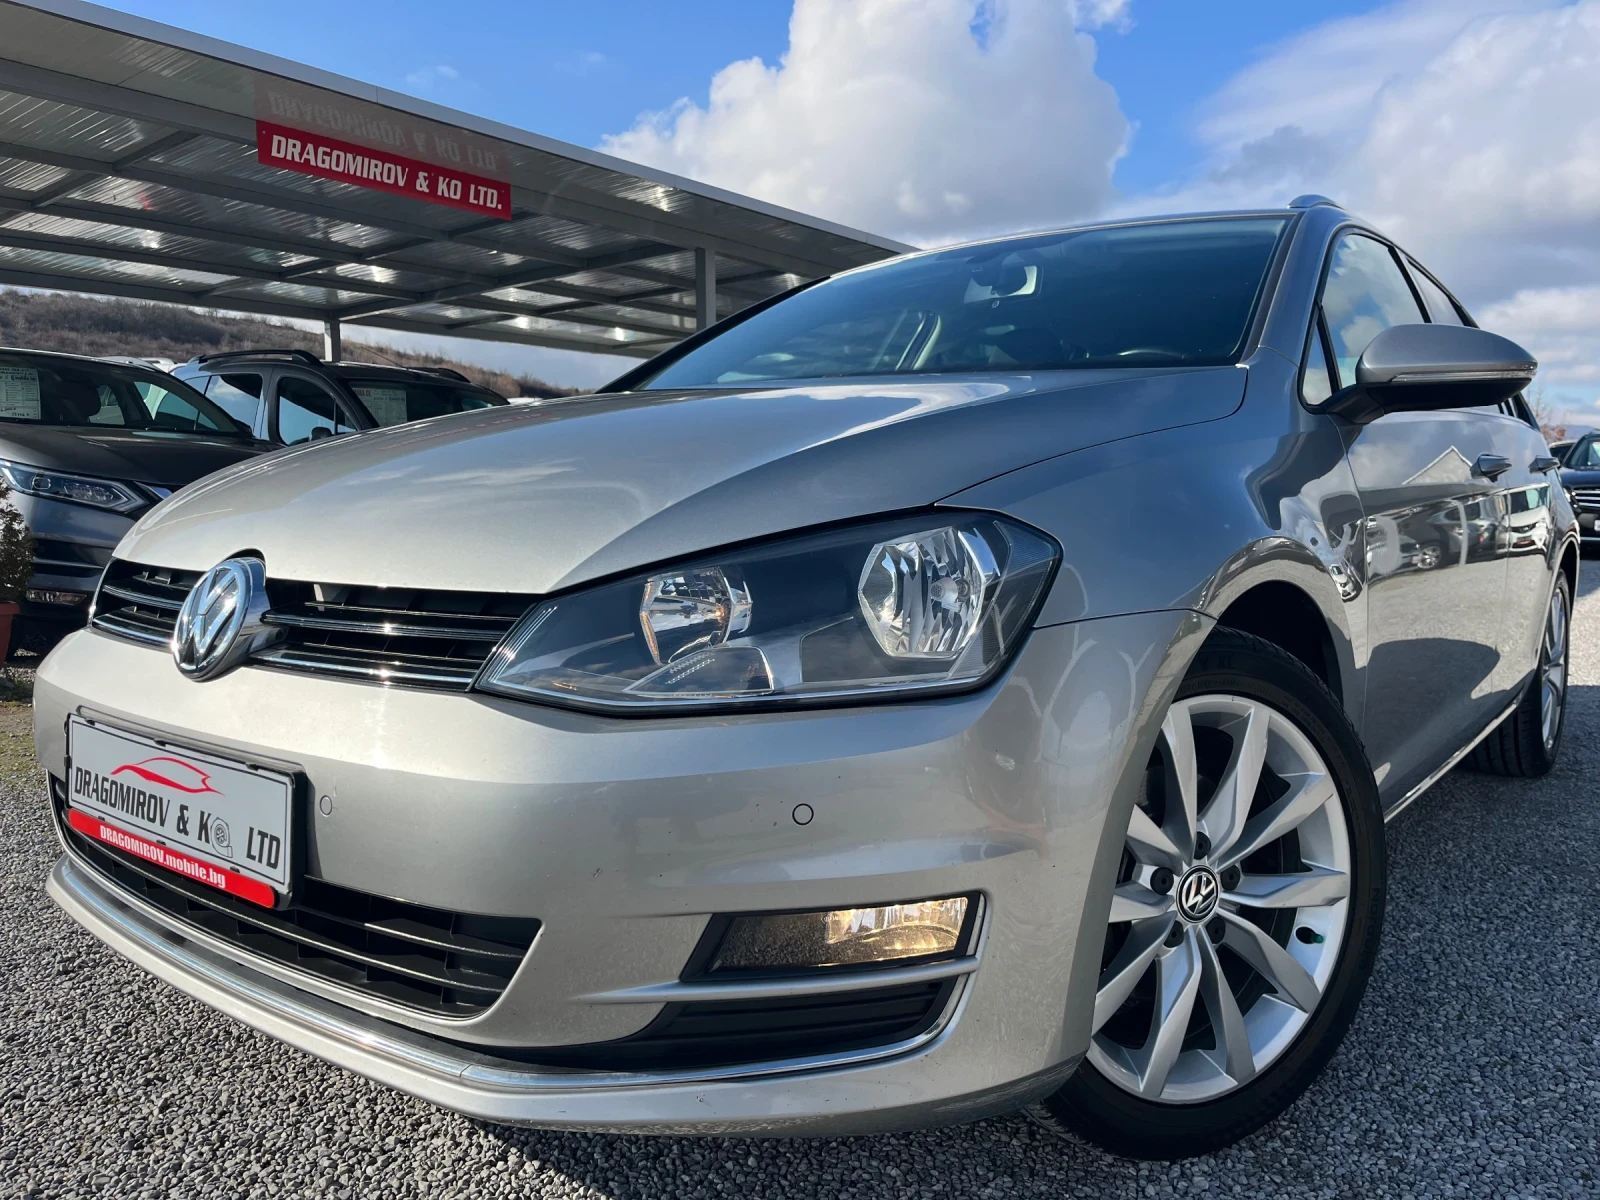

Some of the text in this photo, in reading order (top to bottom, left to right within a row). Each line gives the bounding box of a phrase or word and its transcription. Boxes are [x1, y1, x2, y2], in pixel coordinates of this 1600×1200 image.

[271, 134, 502, 210] DRAGOMIROV & KO LTD.
[74, 766, 170, 827] DRAGOMIROV
[176, 804, 189, 836] &
[246, 826, 281, 870] LTD
[100, 824, 226, 889] DRAGOMIROV.mobile.bg
